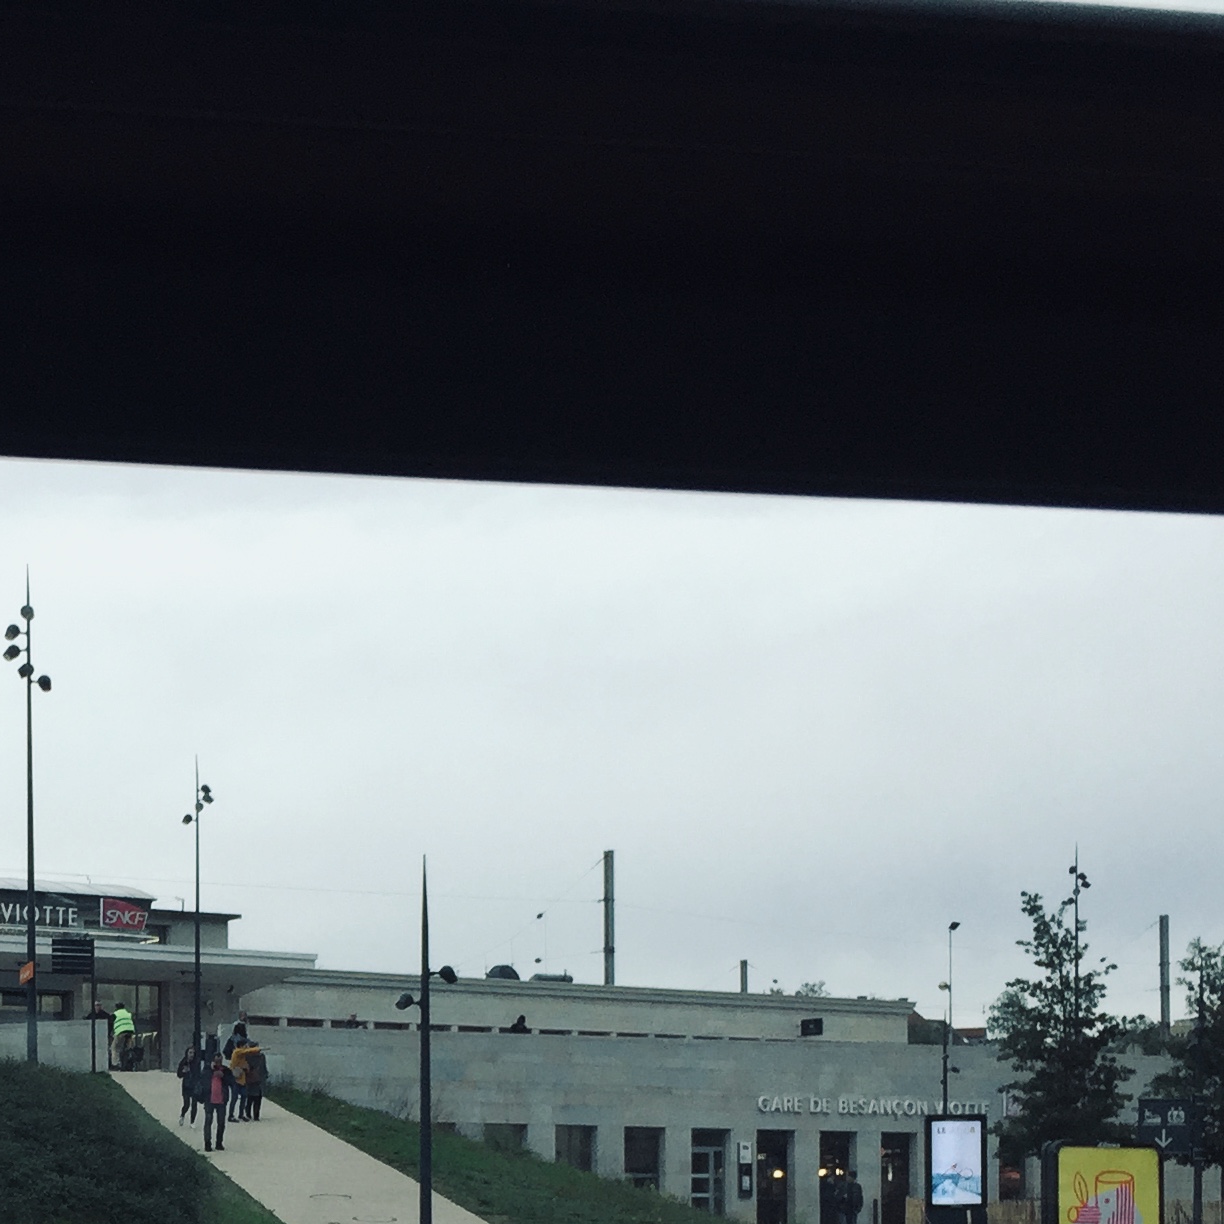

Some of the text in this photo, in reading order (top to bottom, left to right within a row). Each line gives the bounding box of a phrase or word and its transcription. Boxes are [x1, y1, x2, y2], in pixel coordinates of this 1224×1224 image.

[105, 909, 148, 925] SNCF
[757, 1095, 803, 1113] GARE
[809, 1097, 832, 1114] DE
[838, 1097, 929, 1119] BESANÇON
